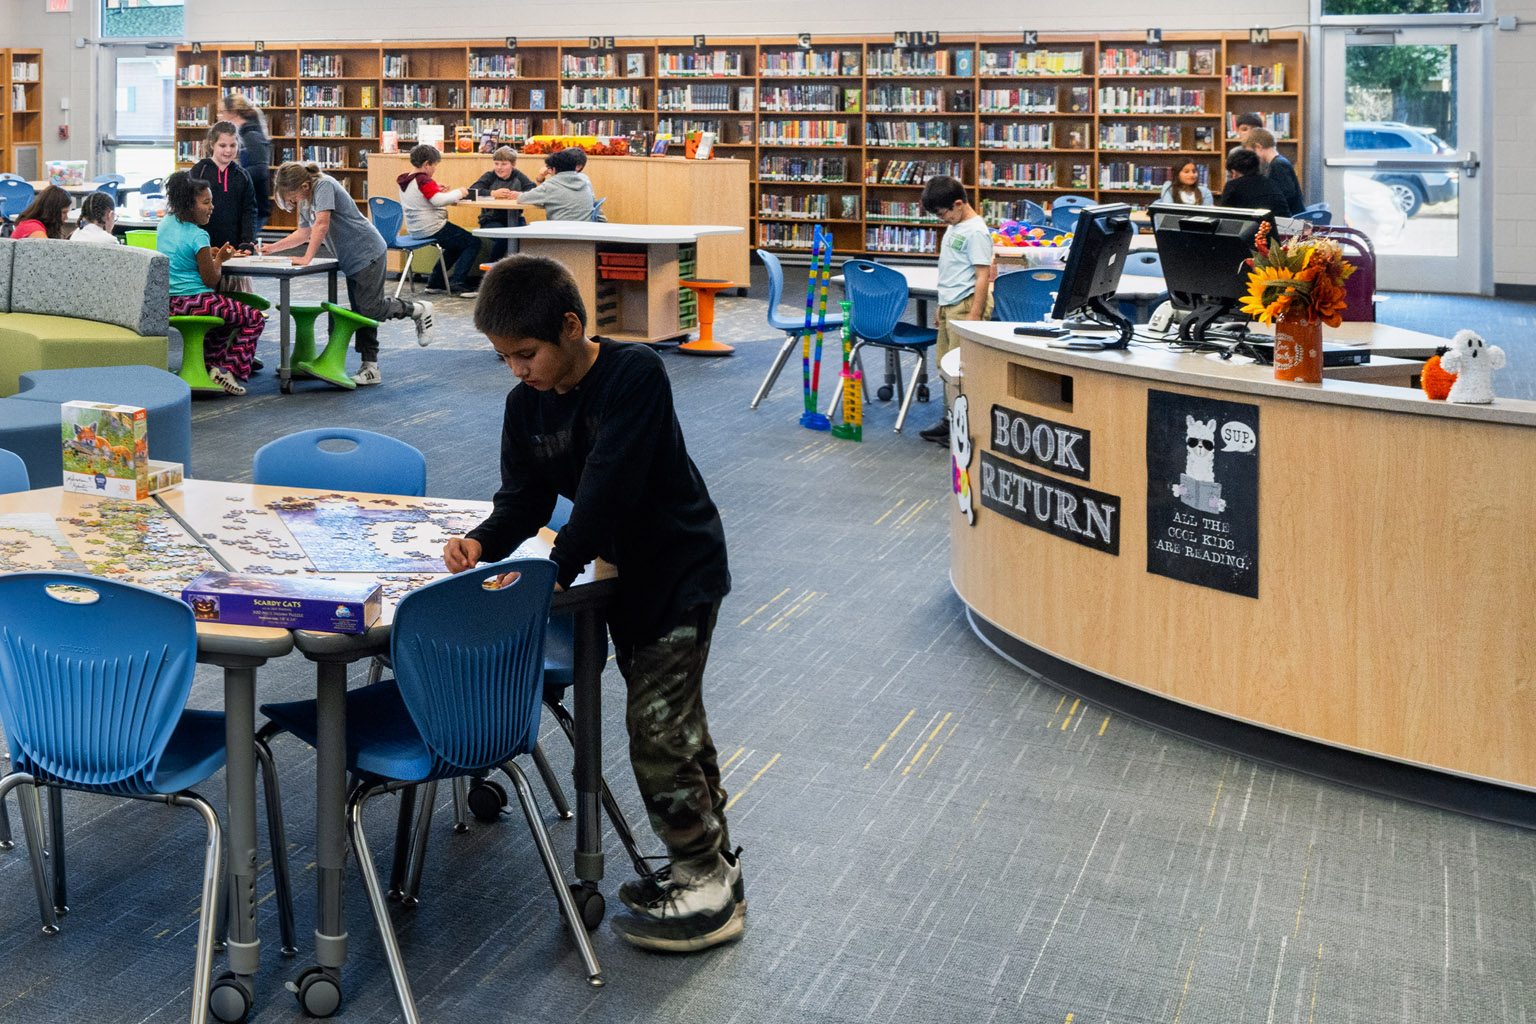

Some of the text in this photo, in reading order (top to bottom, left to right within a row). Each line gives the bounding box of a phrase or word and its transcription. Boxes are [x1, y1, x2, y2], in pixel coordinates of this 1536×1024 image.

[695, 37, 703, 48] F
[798, 36, 811, 48] G
[895, 33, 908, 47] H
[927, 32, 937, 45] J
[1025, 32, 1037, 44] K
[1146, 29, 1160, 44] L
[1250, 29, 1268, 43] M
[192, 43, 202, 54] A
[256, 42, 264, 52] B
[506, 38, 516, 49] C
[589, 38, 613, 49] D E
[994, 410, 1085, 472] BOOK
[1224, 429, 1254, 444] SUP.
[982, 461, 1116, 544] RETURN
[1172, 512, 1230, 533] ALL THE
[1202, 534, 1235, 551] KIDS
[1156, 539, 1249, 570] ARE READING.
[253, 598, 302, 608] SCARDY CATS
